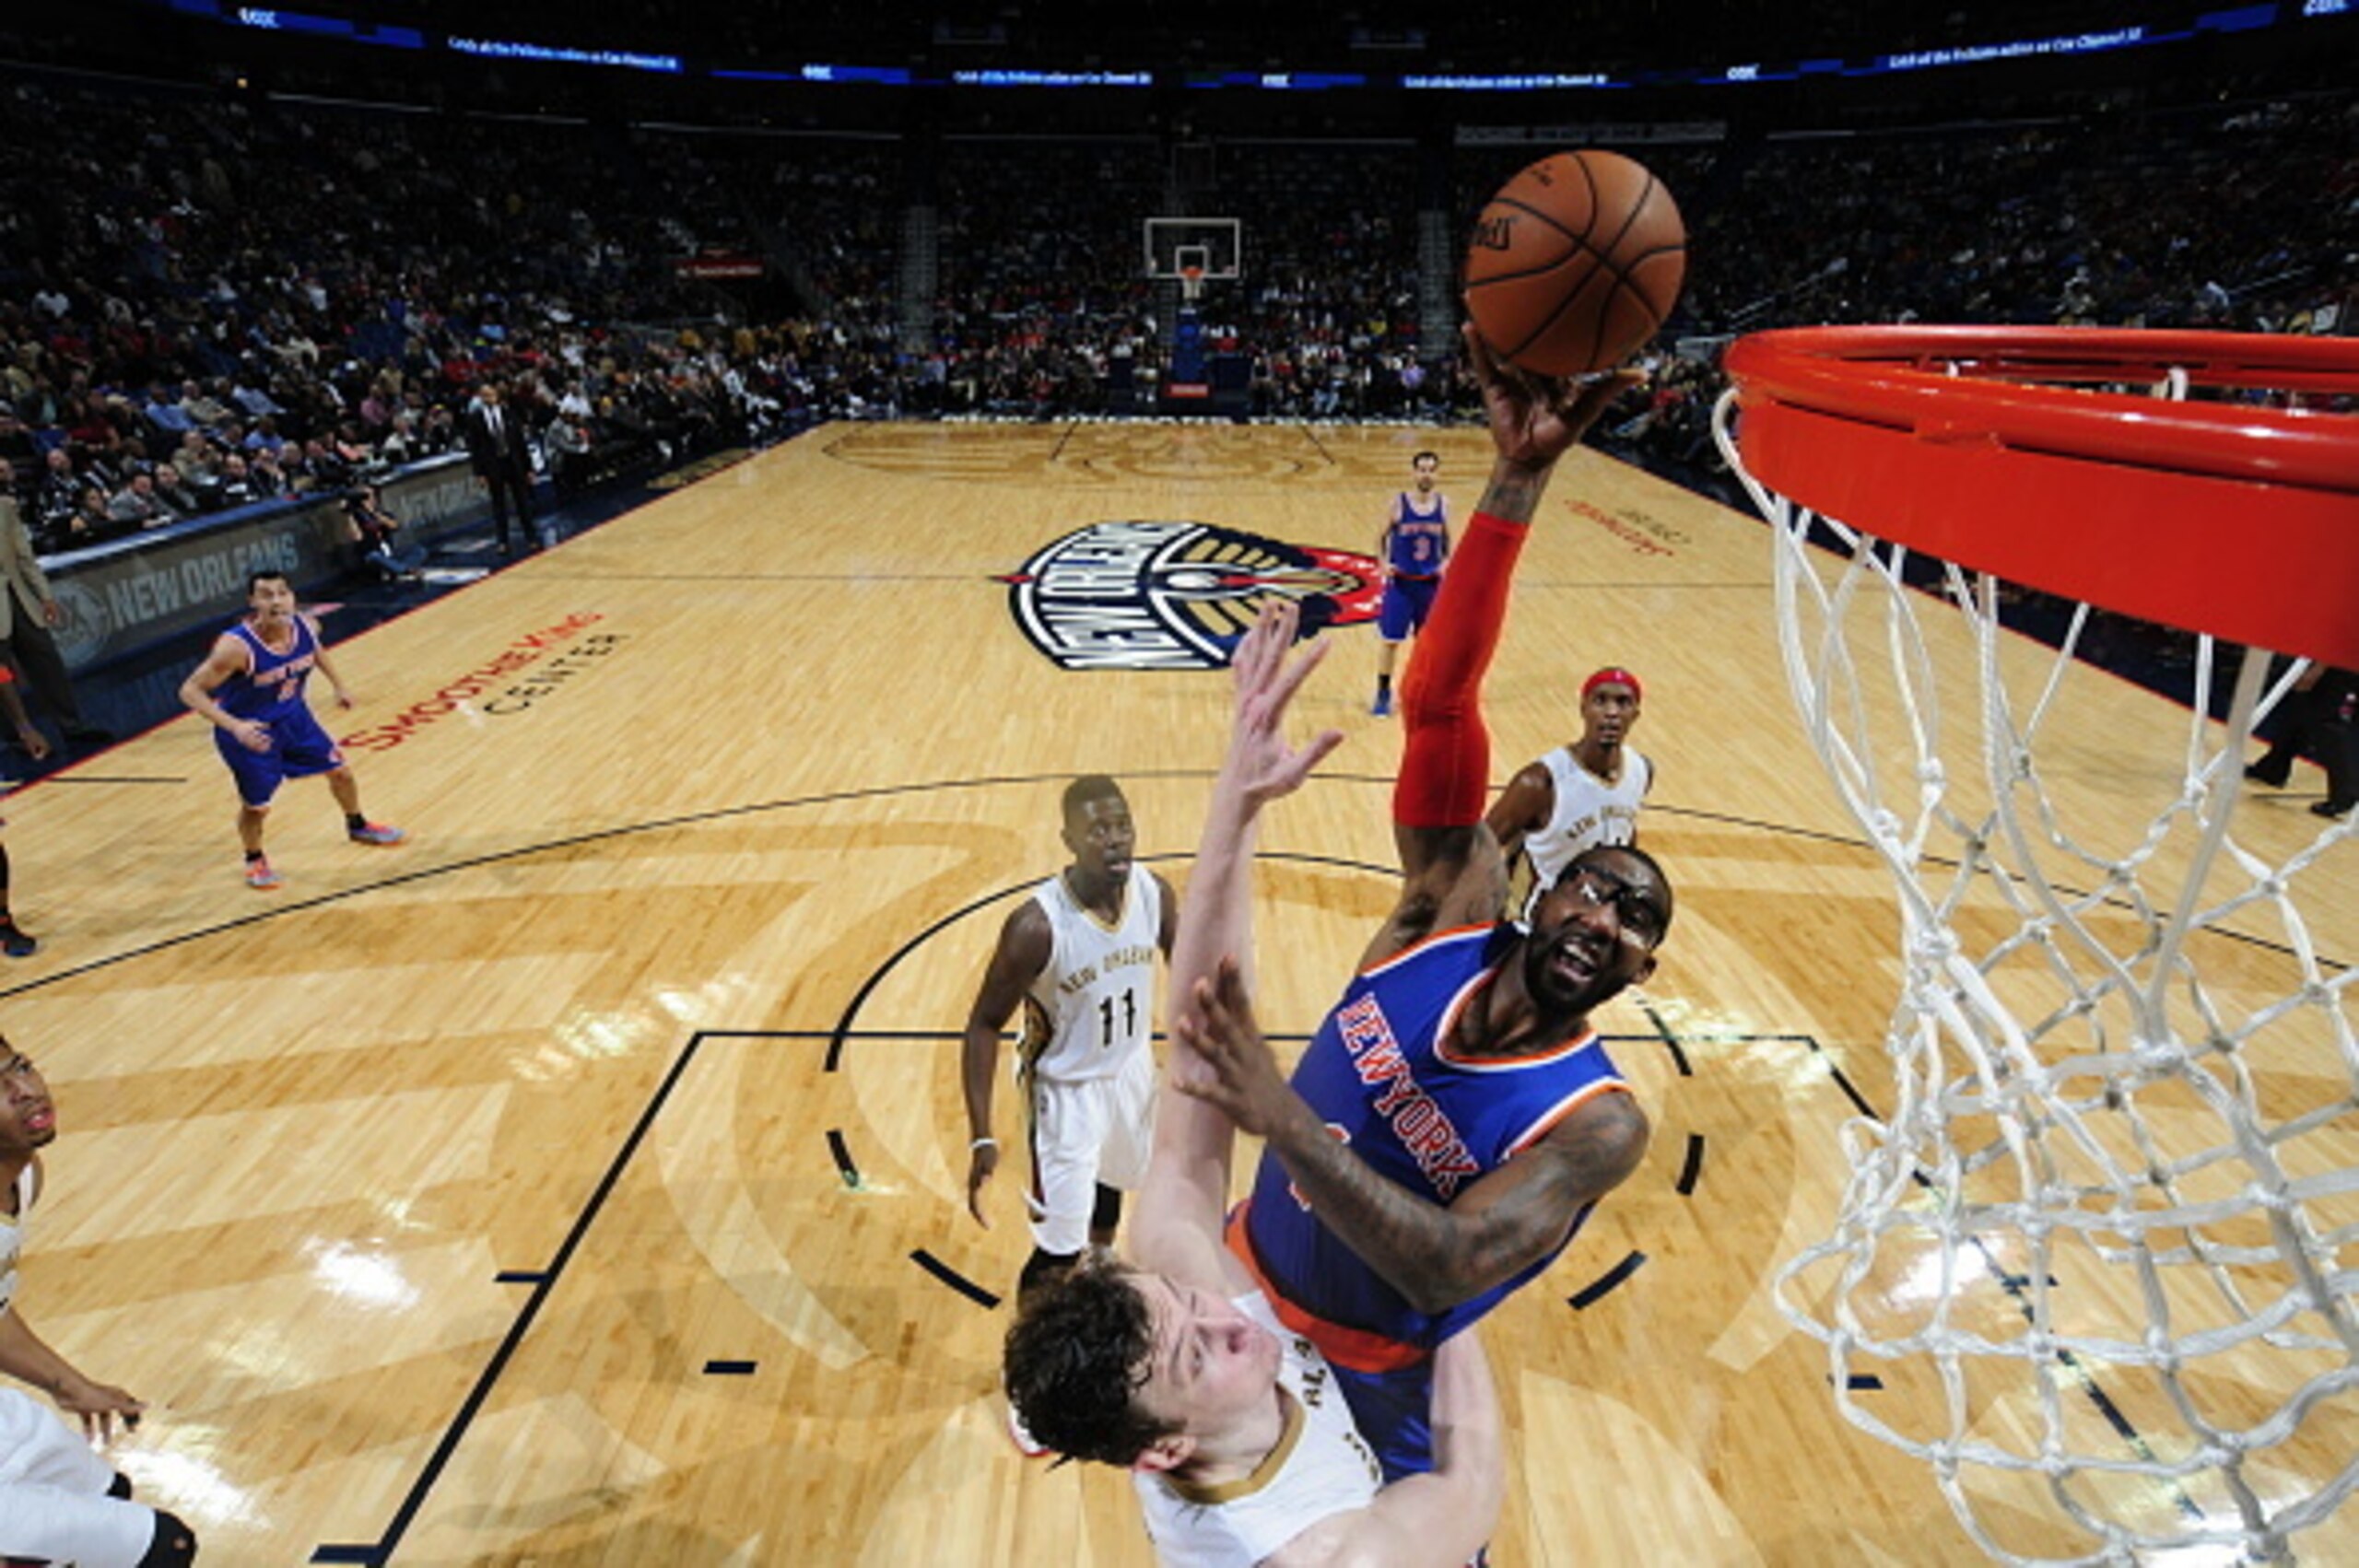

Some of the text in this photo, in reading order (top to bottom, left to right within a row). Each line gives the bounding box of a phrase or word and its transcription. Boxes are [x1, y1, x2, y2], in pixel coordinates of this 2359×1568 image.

[106, 531, 299, 630] NEW ORLEANS
[482, 633, 630, 716] CENTER
[1098, 987, 1137, 1047] 11
[1337, 990, 1483, 1199] NEW YORK
